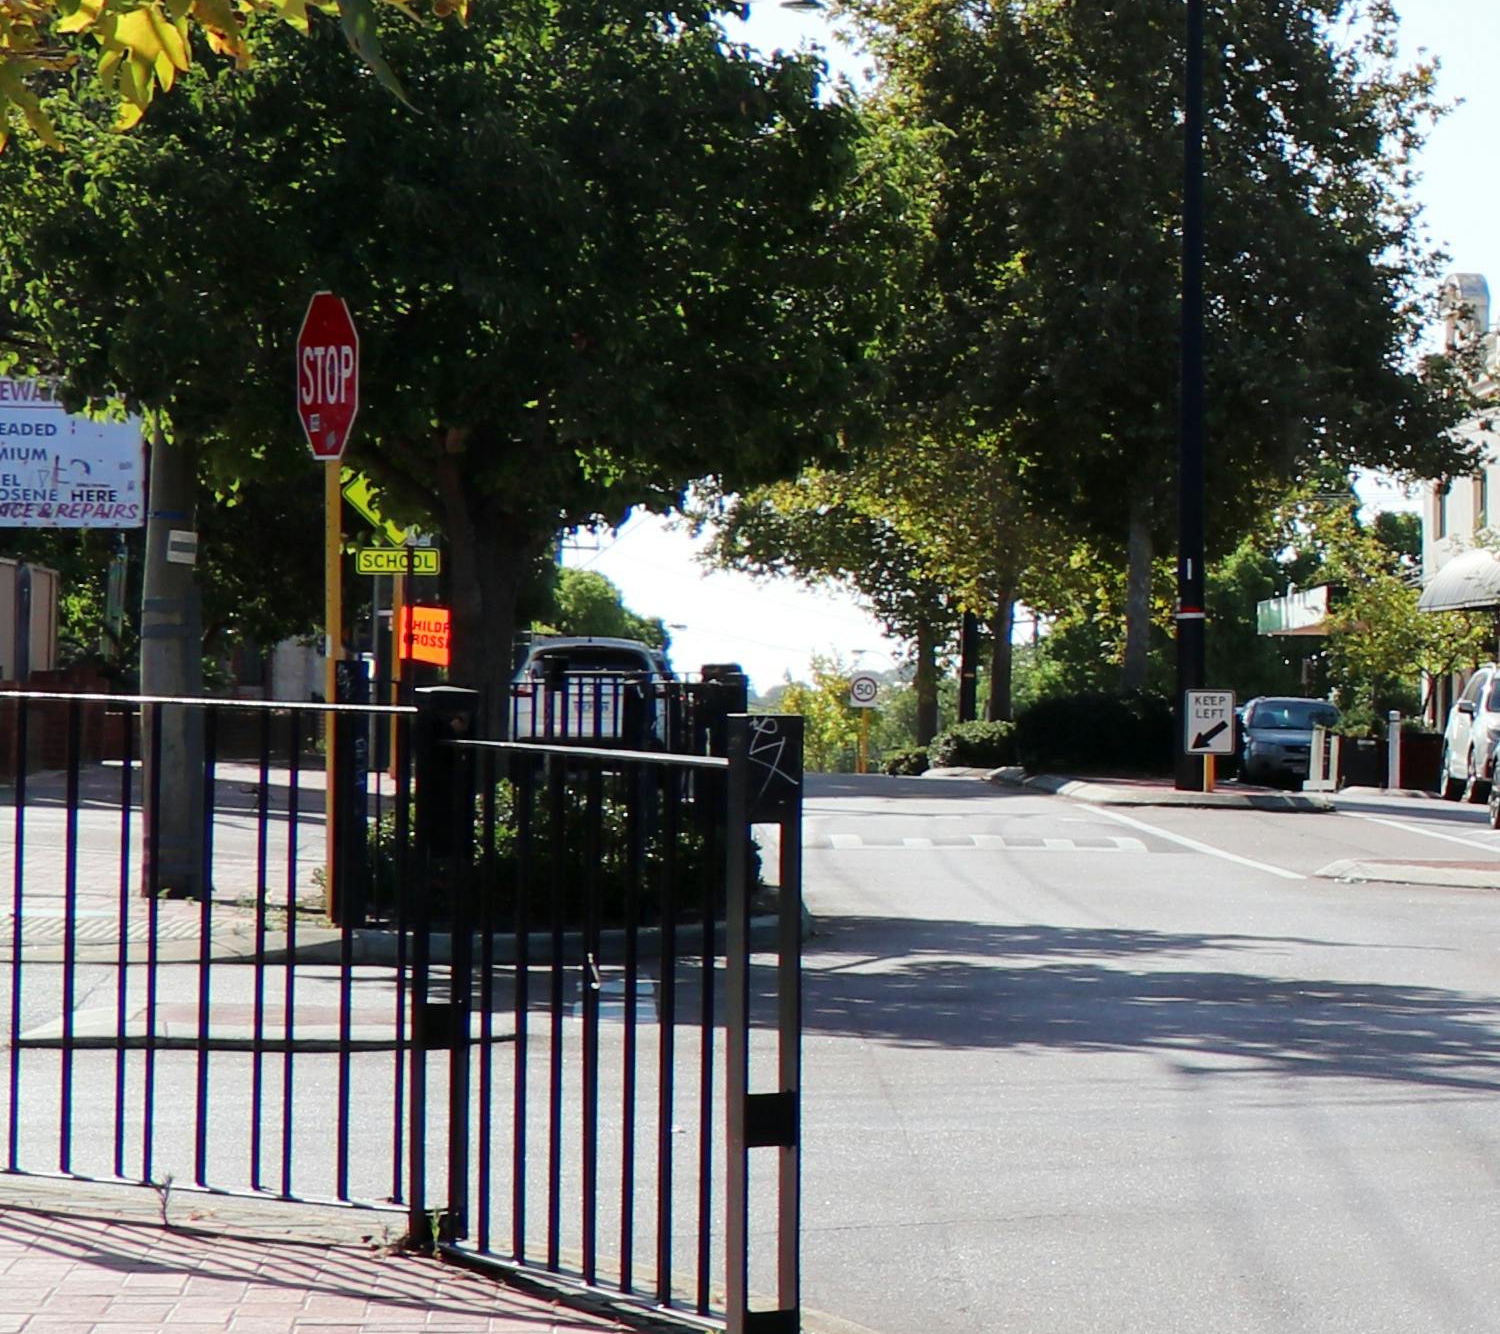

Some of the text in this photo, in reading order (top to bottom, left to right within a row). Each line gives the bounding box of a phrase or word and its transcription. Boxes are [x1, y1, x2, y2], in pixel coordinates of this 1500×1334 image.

[302, 345, 353, 405] STOP
[0, 423, 58, 436] EADED
[71, 490, 117, 502] HERE
[38, 503, 51, 518] &
[56, 504, 139, 519] REPAIRS
[363, 554, 434, 569] SCHOOL
[856, 683, 873, 696] 50
[1194, 696, 1226, 706] KEEP
[1195, 708, 1224, 719] LEFT
